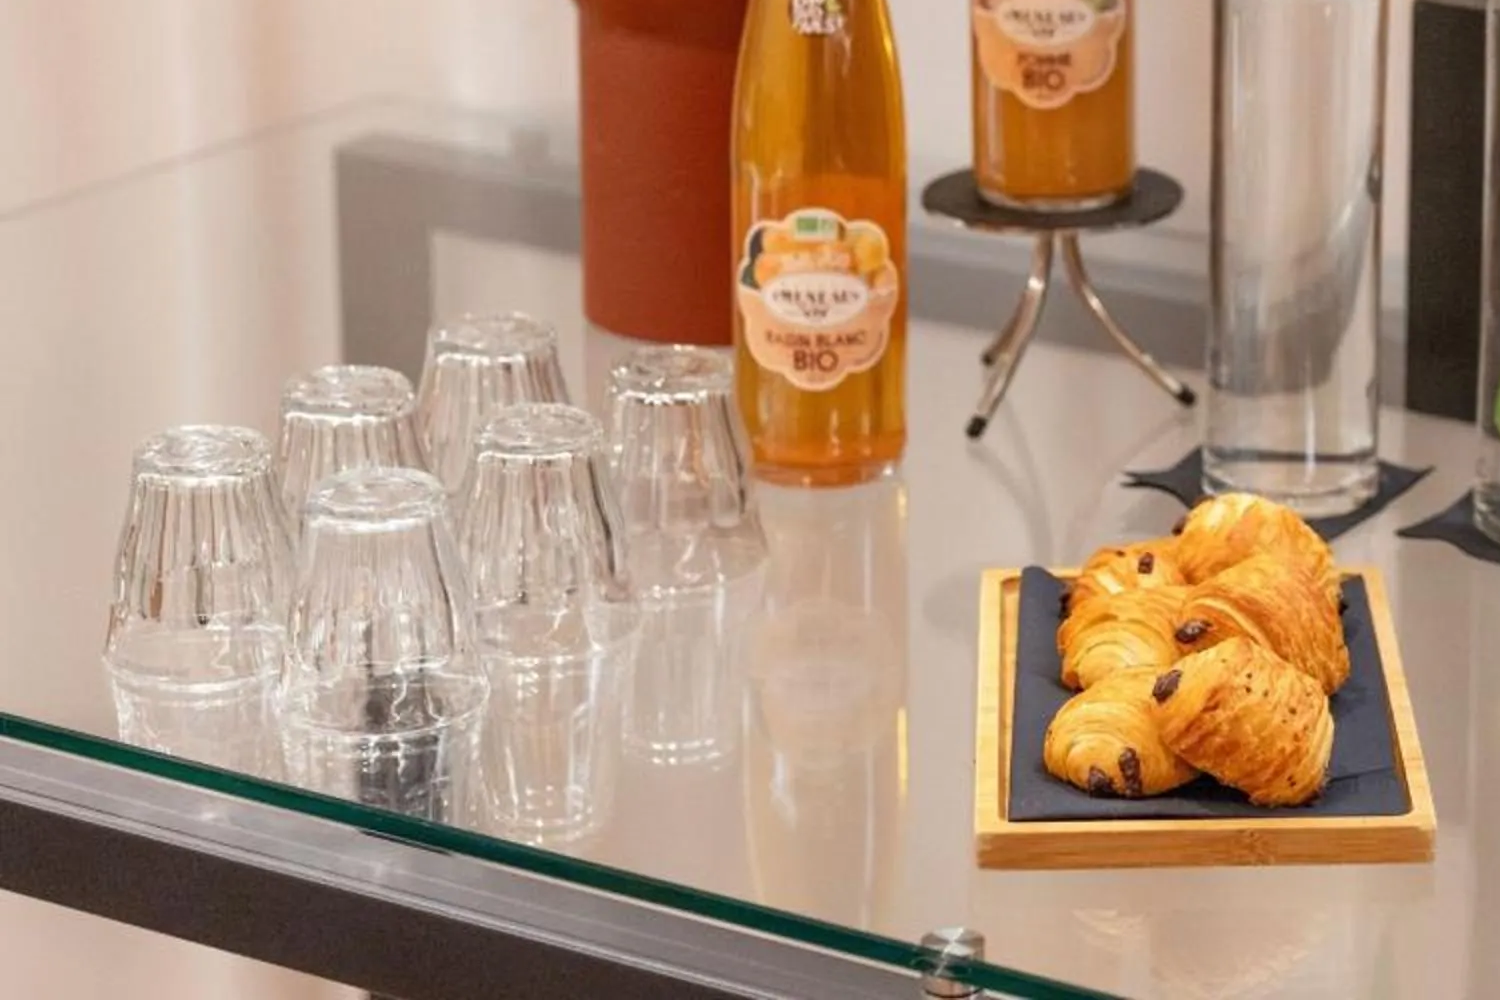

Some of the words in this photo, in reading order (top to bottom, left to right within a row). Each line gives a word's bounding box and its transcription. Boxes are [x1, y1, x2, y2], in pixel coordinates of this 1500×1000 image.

[1021, 68, 1066, 90] BIO
[815, 329, 867, 347] BLANC
[792, 349, 840, 373] BIO
